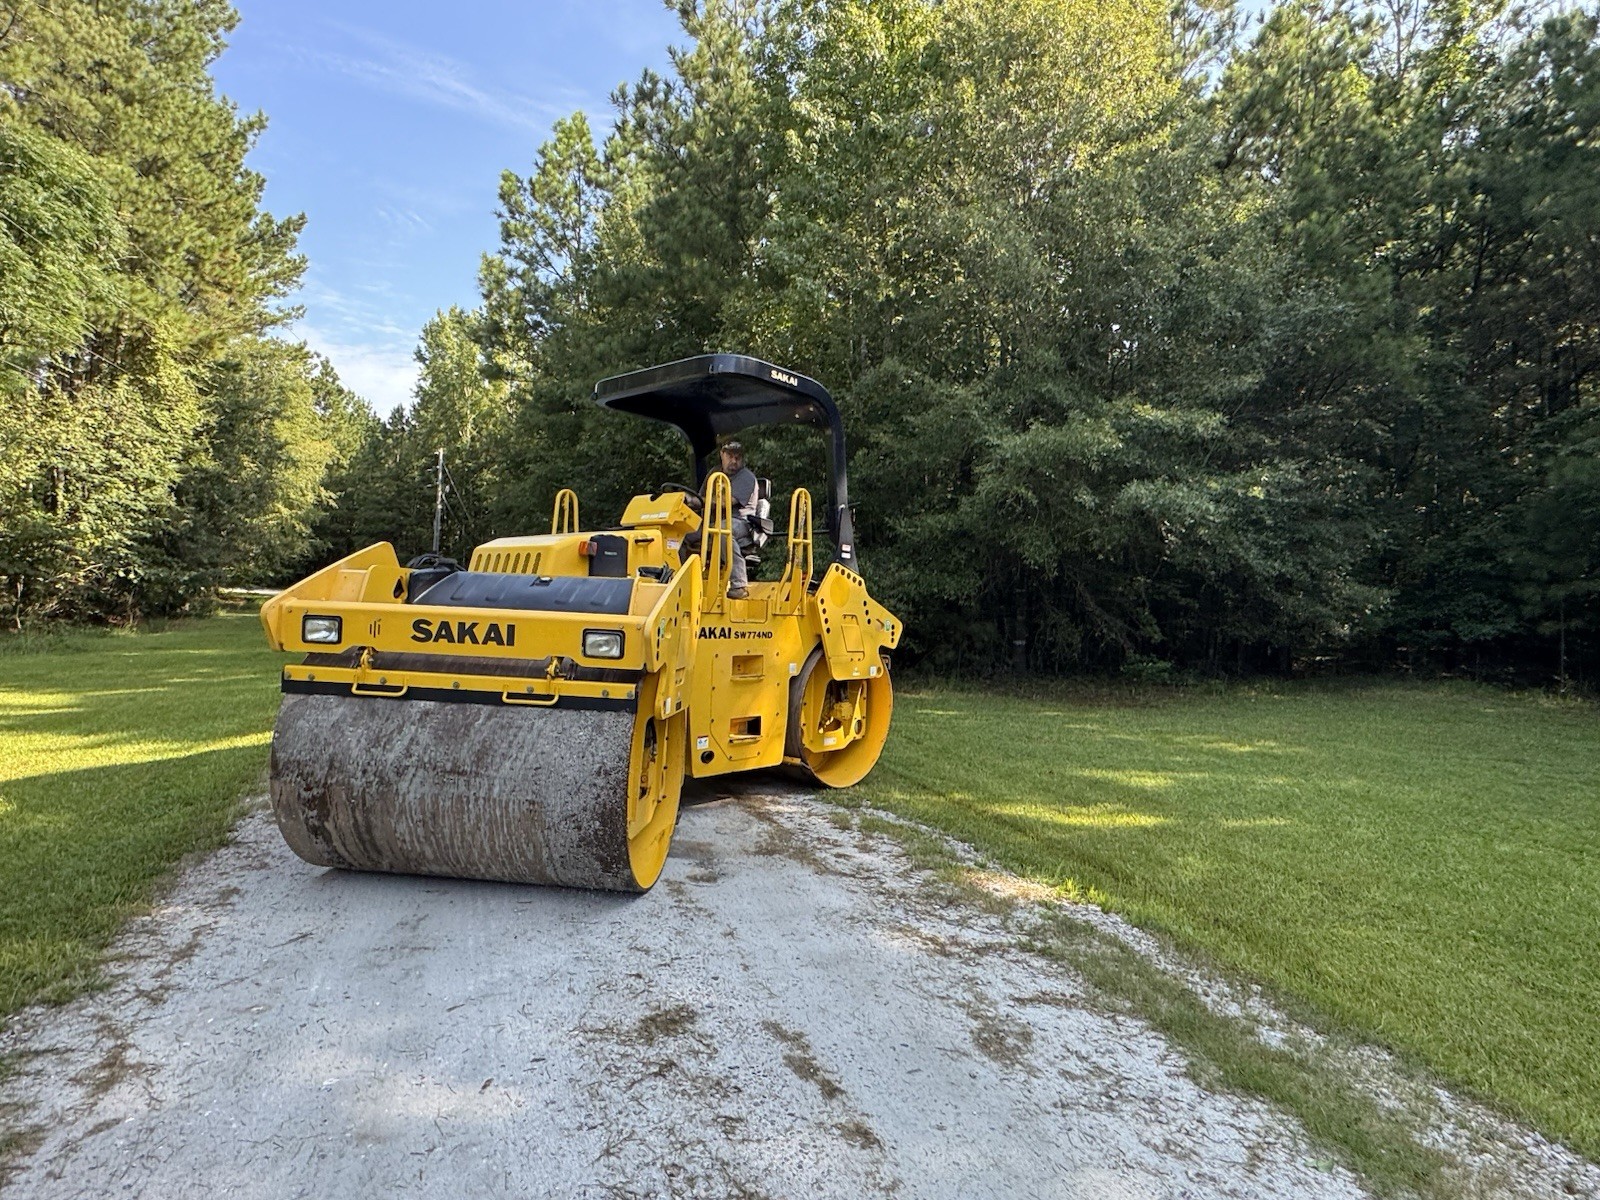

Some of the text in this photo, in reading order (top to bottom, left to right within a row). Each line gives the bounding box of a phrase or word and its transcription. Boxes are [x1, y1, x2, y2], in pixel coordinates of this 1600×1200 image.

[770, 369, 798, 387] SAKAI
[410, 618, 516, 647] SAKAI
[698, 626, 773, 640] AKAI SW774ND
